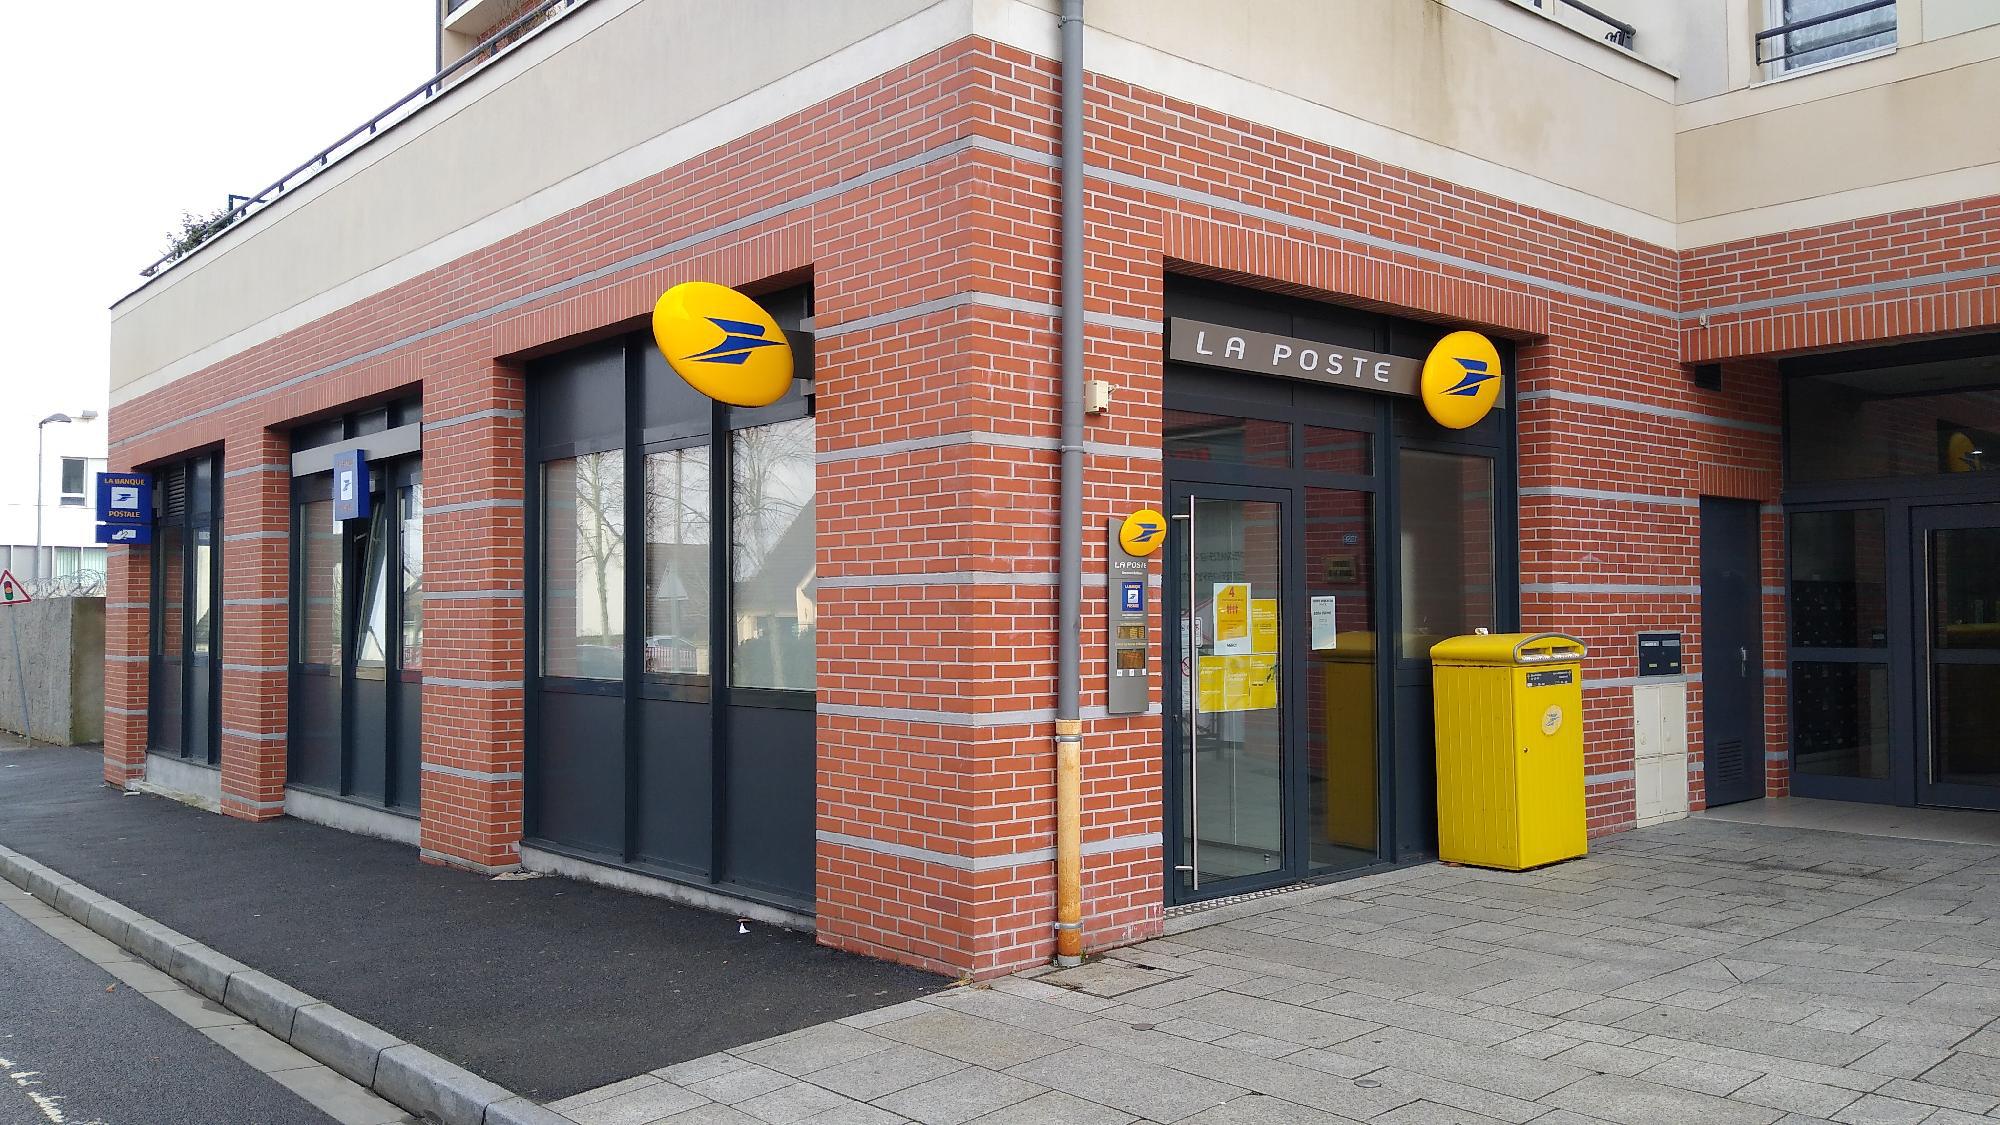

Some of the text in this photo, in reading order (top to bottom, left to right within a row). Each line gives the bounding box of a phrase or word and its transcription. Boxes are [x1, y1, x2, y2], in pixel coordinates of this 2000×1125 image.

[1196, 331, 1391, 382] LA POSTE
[1228, 586, 1235, 598] 4
